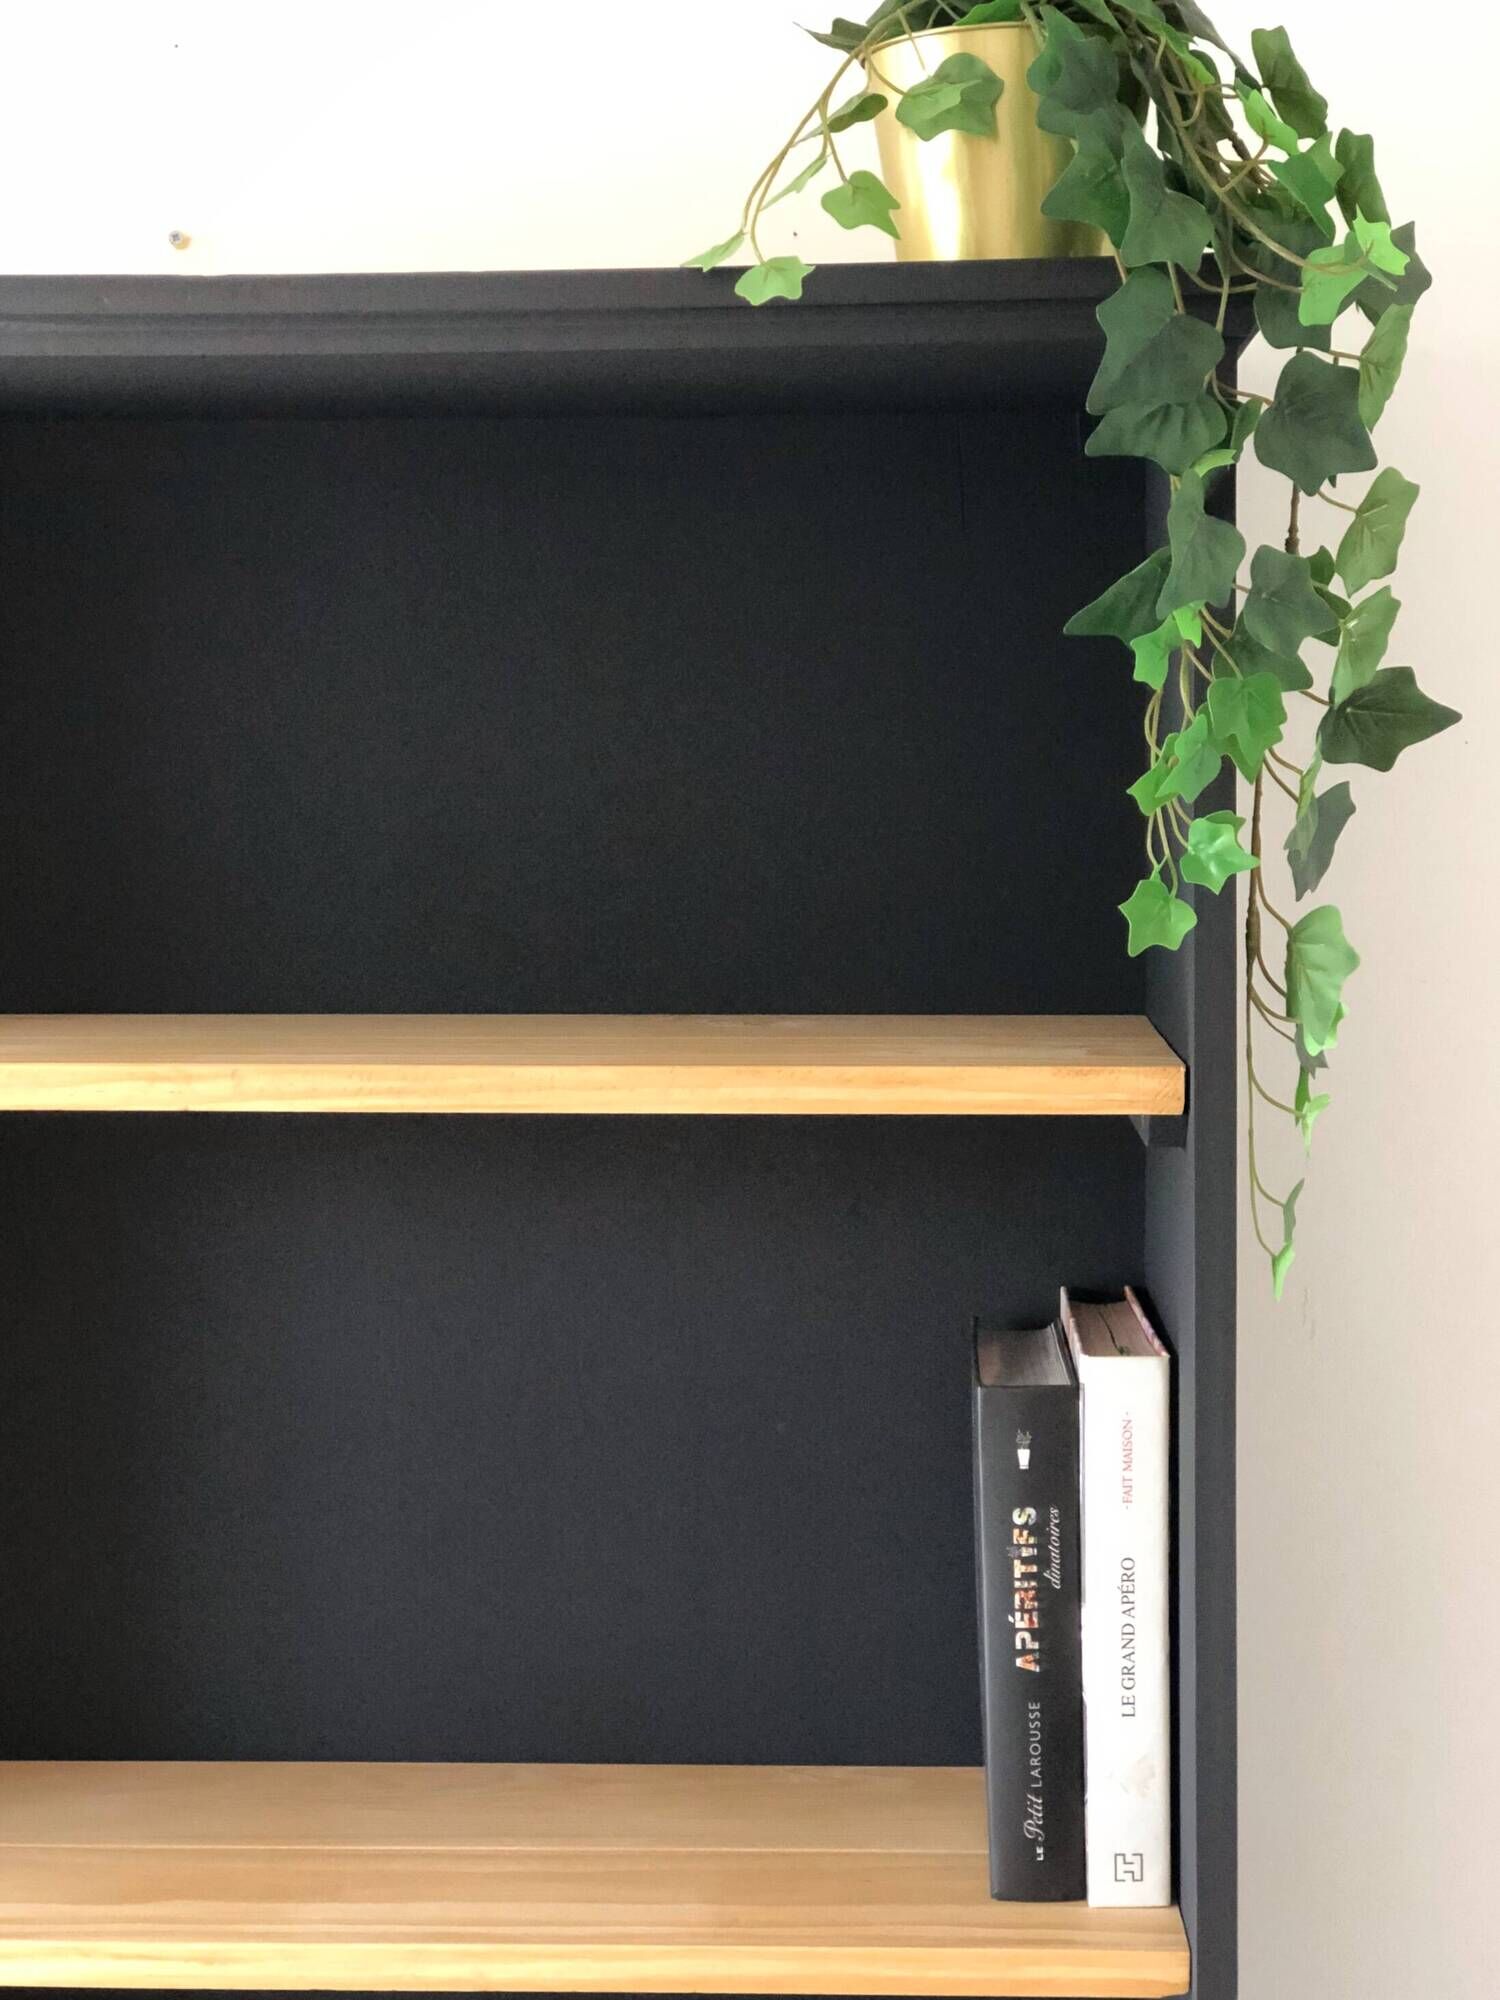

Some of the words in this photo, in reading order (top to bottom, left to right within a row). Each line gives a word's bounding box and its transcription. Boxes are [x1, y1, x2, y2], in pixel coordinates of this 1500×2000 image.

[1008, 1507, 1040, 1673] APÉRITIFS
[1117, 1557, 1135, 1619] APÉRO
[1120, 1623, 1135, 1690] GRAND
[1121, 1695, 1135, 1718] LE
[1028, 1701, 1042, 1788] LAROUSSE
[1024, 1794, 1045, 1841] Petit
[1036, 1846, 1044, 1861] LE
